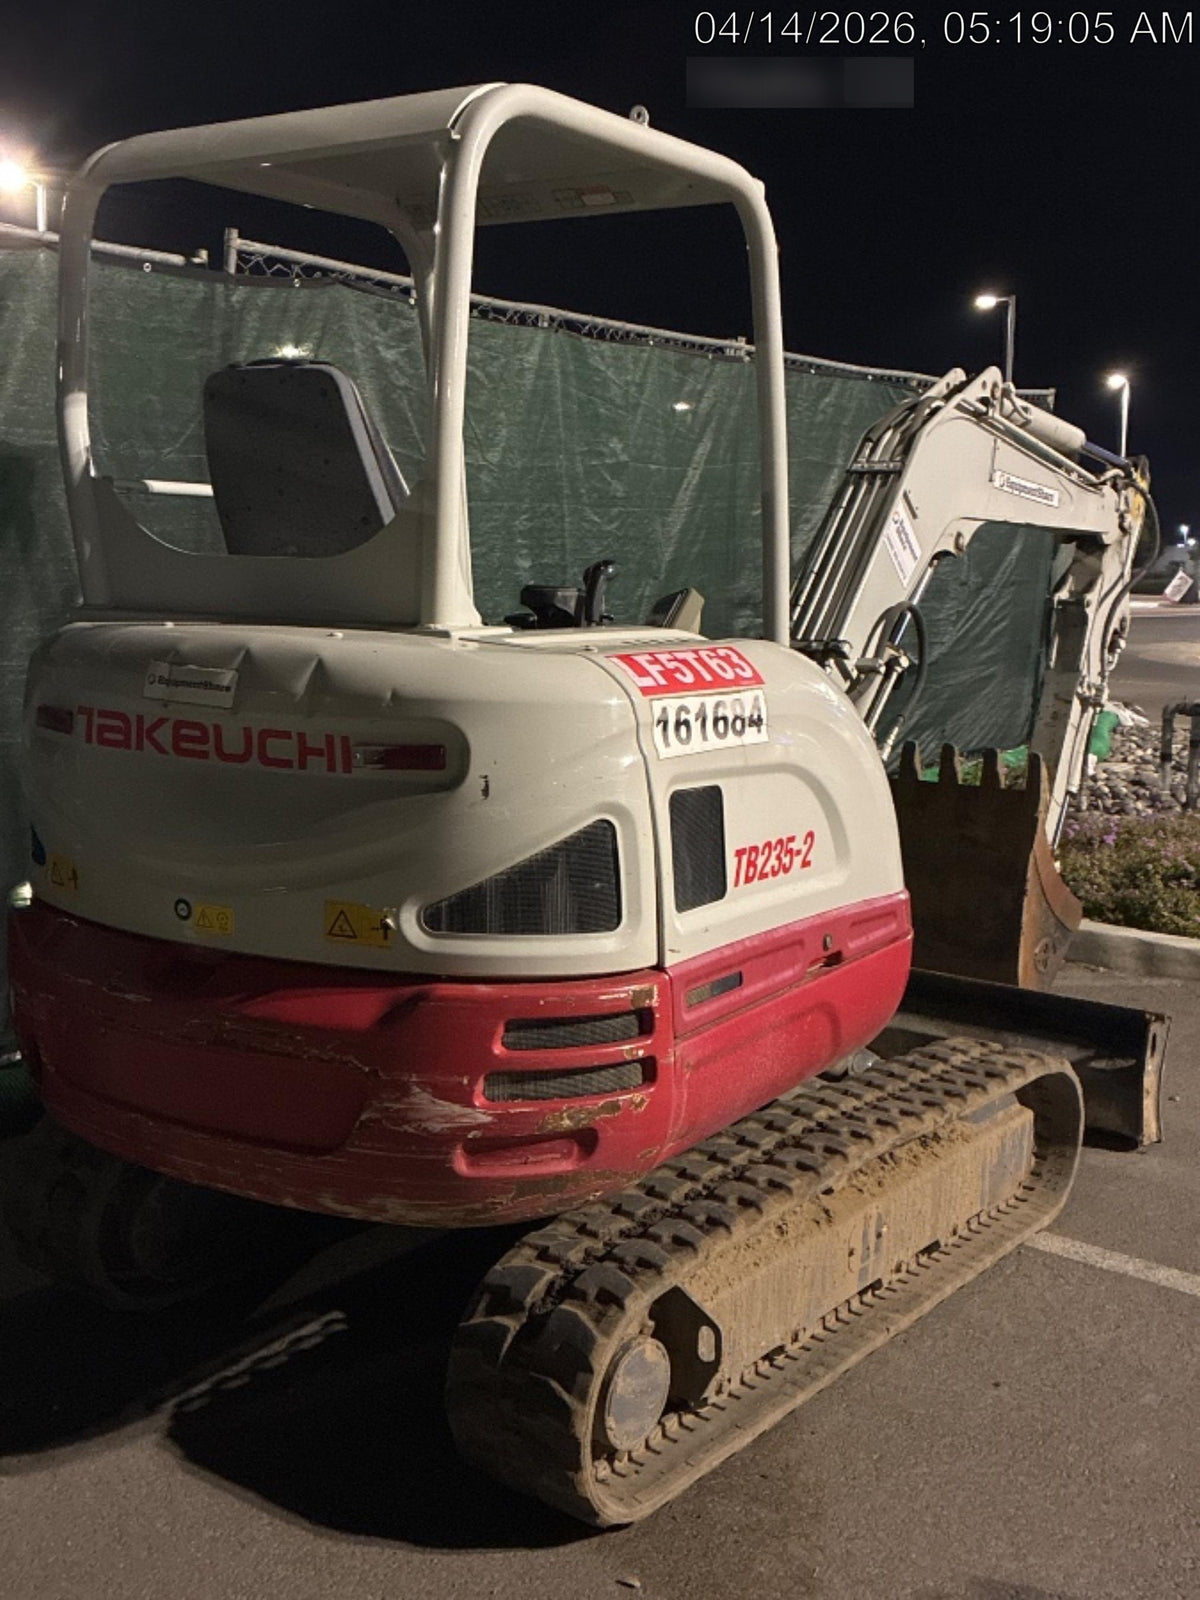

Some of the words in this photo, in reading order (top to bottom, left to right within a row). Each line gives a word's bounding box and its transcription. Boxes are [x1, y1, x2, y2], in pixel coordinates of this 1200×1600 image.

[609, 648, 753, 687] LF5T63
[656, 695, 763, 748] 161684
[733, 830, 815, 888] TB235-2
